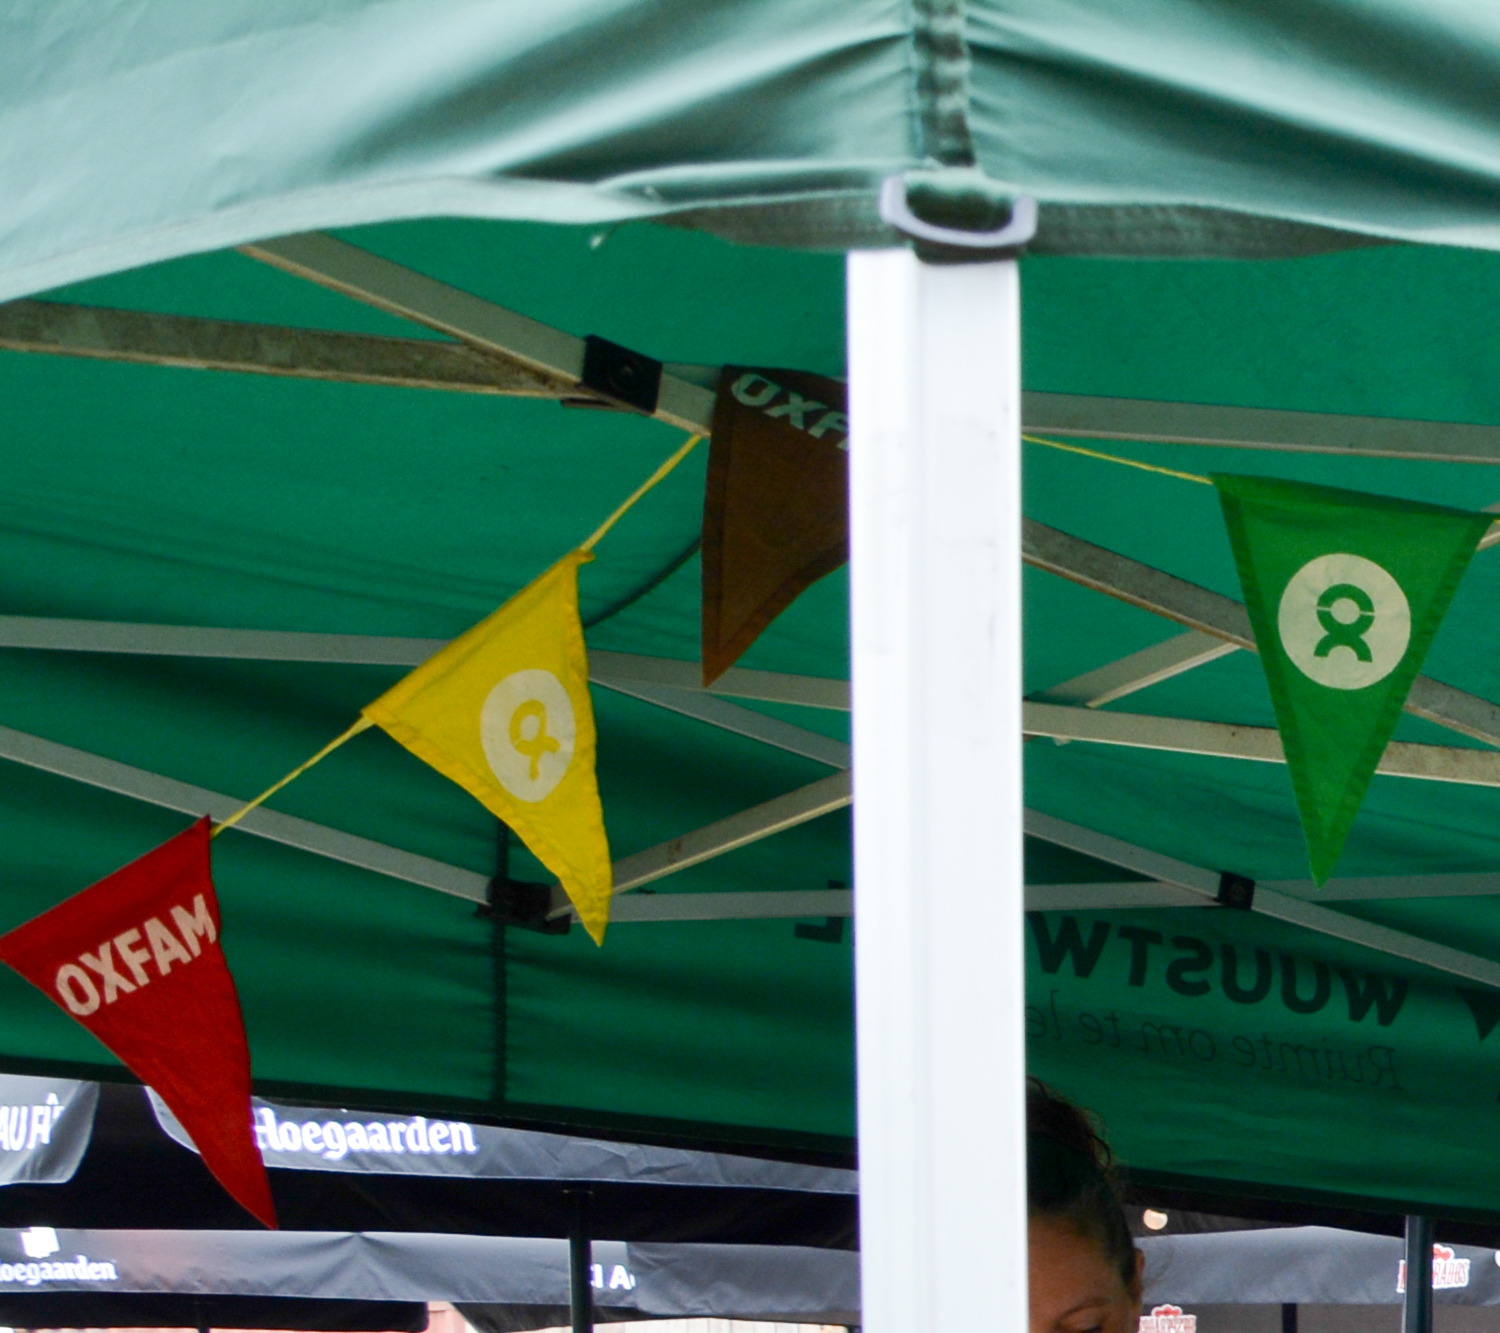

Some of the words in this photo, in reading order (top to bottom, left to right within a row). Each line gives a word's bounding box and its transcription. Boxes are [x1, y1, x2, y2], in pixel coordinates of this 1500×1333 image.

[731, 373, 849, 451] OXF
[55, 893, 217, 1016] OXFAM
[253, 1106, 478, 1160] Hoegaarden
[0, 1256, 118, 1285] oegaarden
